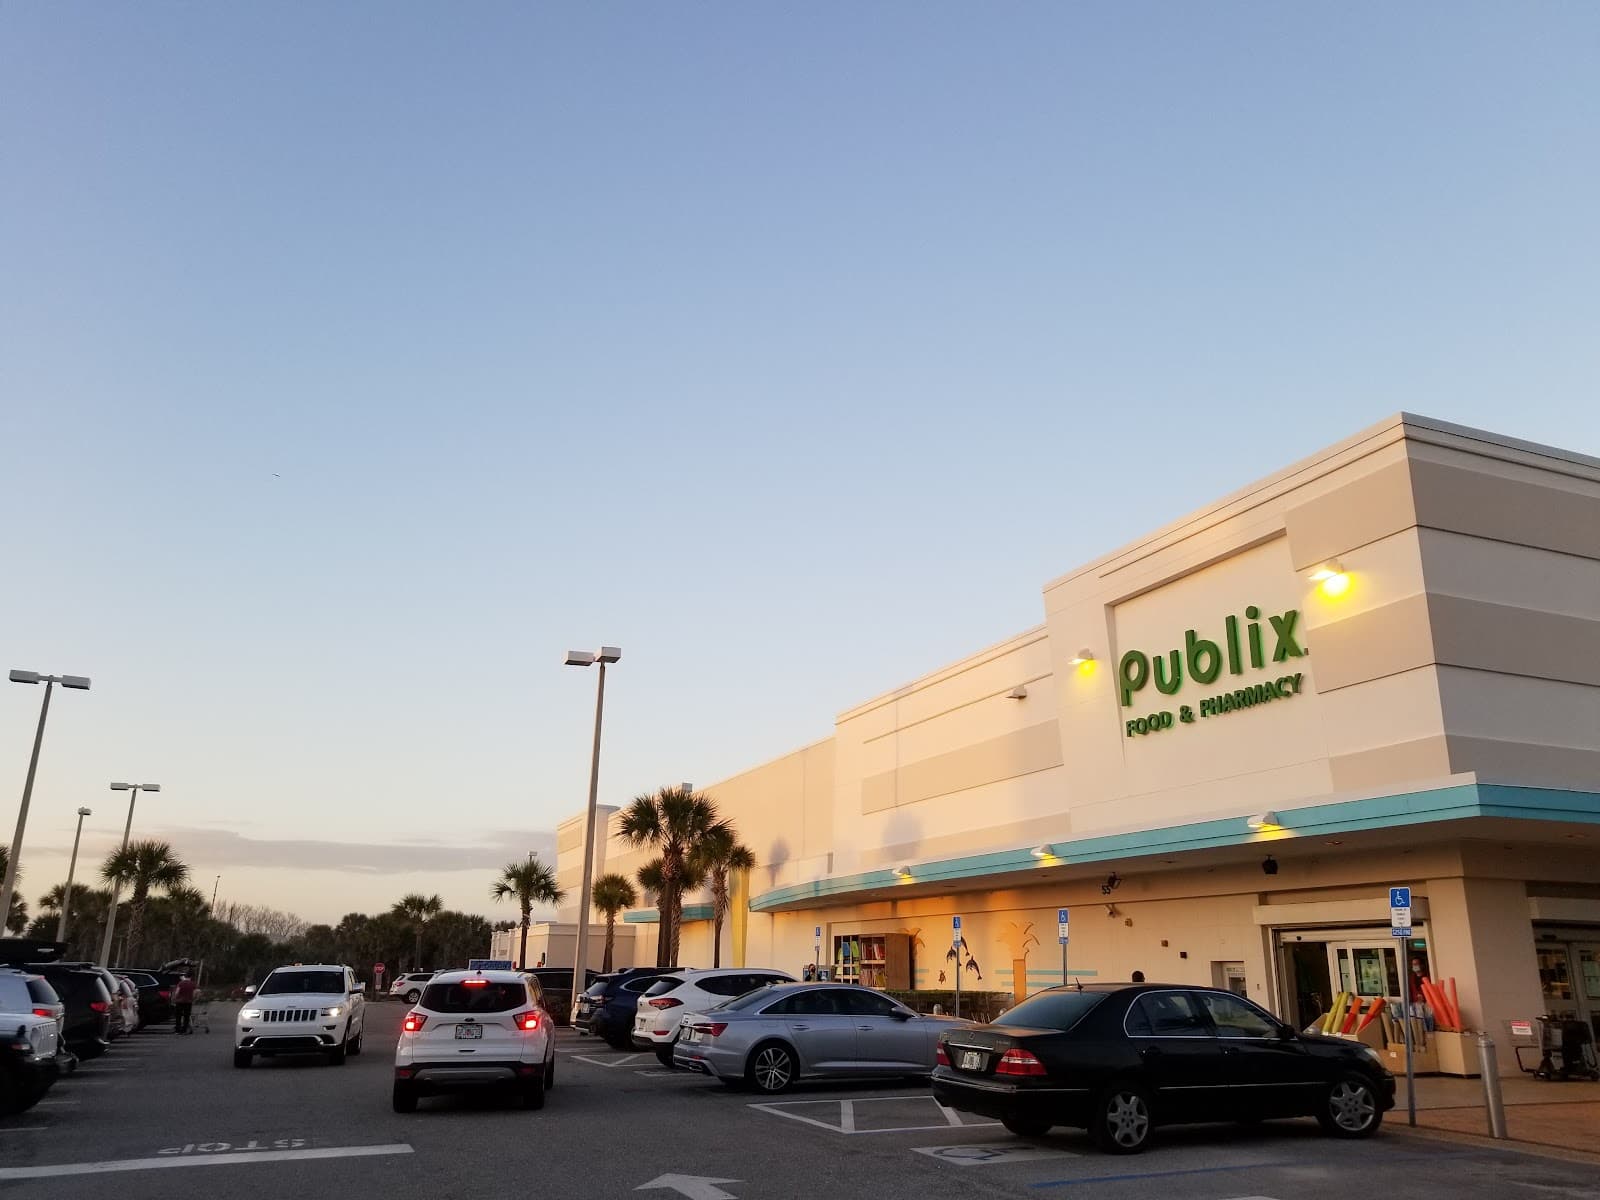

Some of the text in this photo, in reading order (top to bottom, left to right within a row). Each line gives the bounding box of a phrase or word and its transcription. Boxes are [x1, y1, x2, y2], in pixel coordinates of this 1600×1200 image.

[1126, 673, 1303, 737] FOOD & PHARMACY
